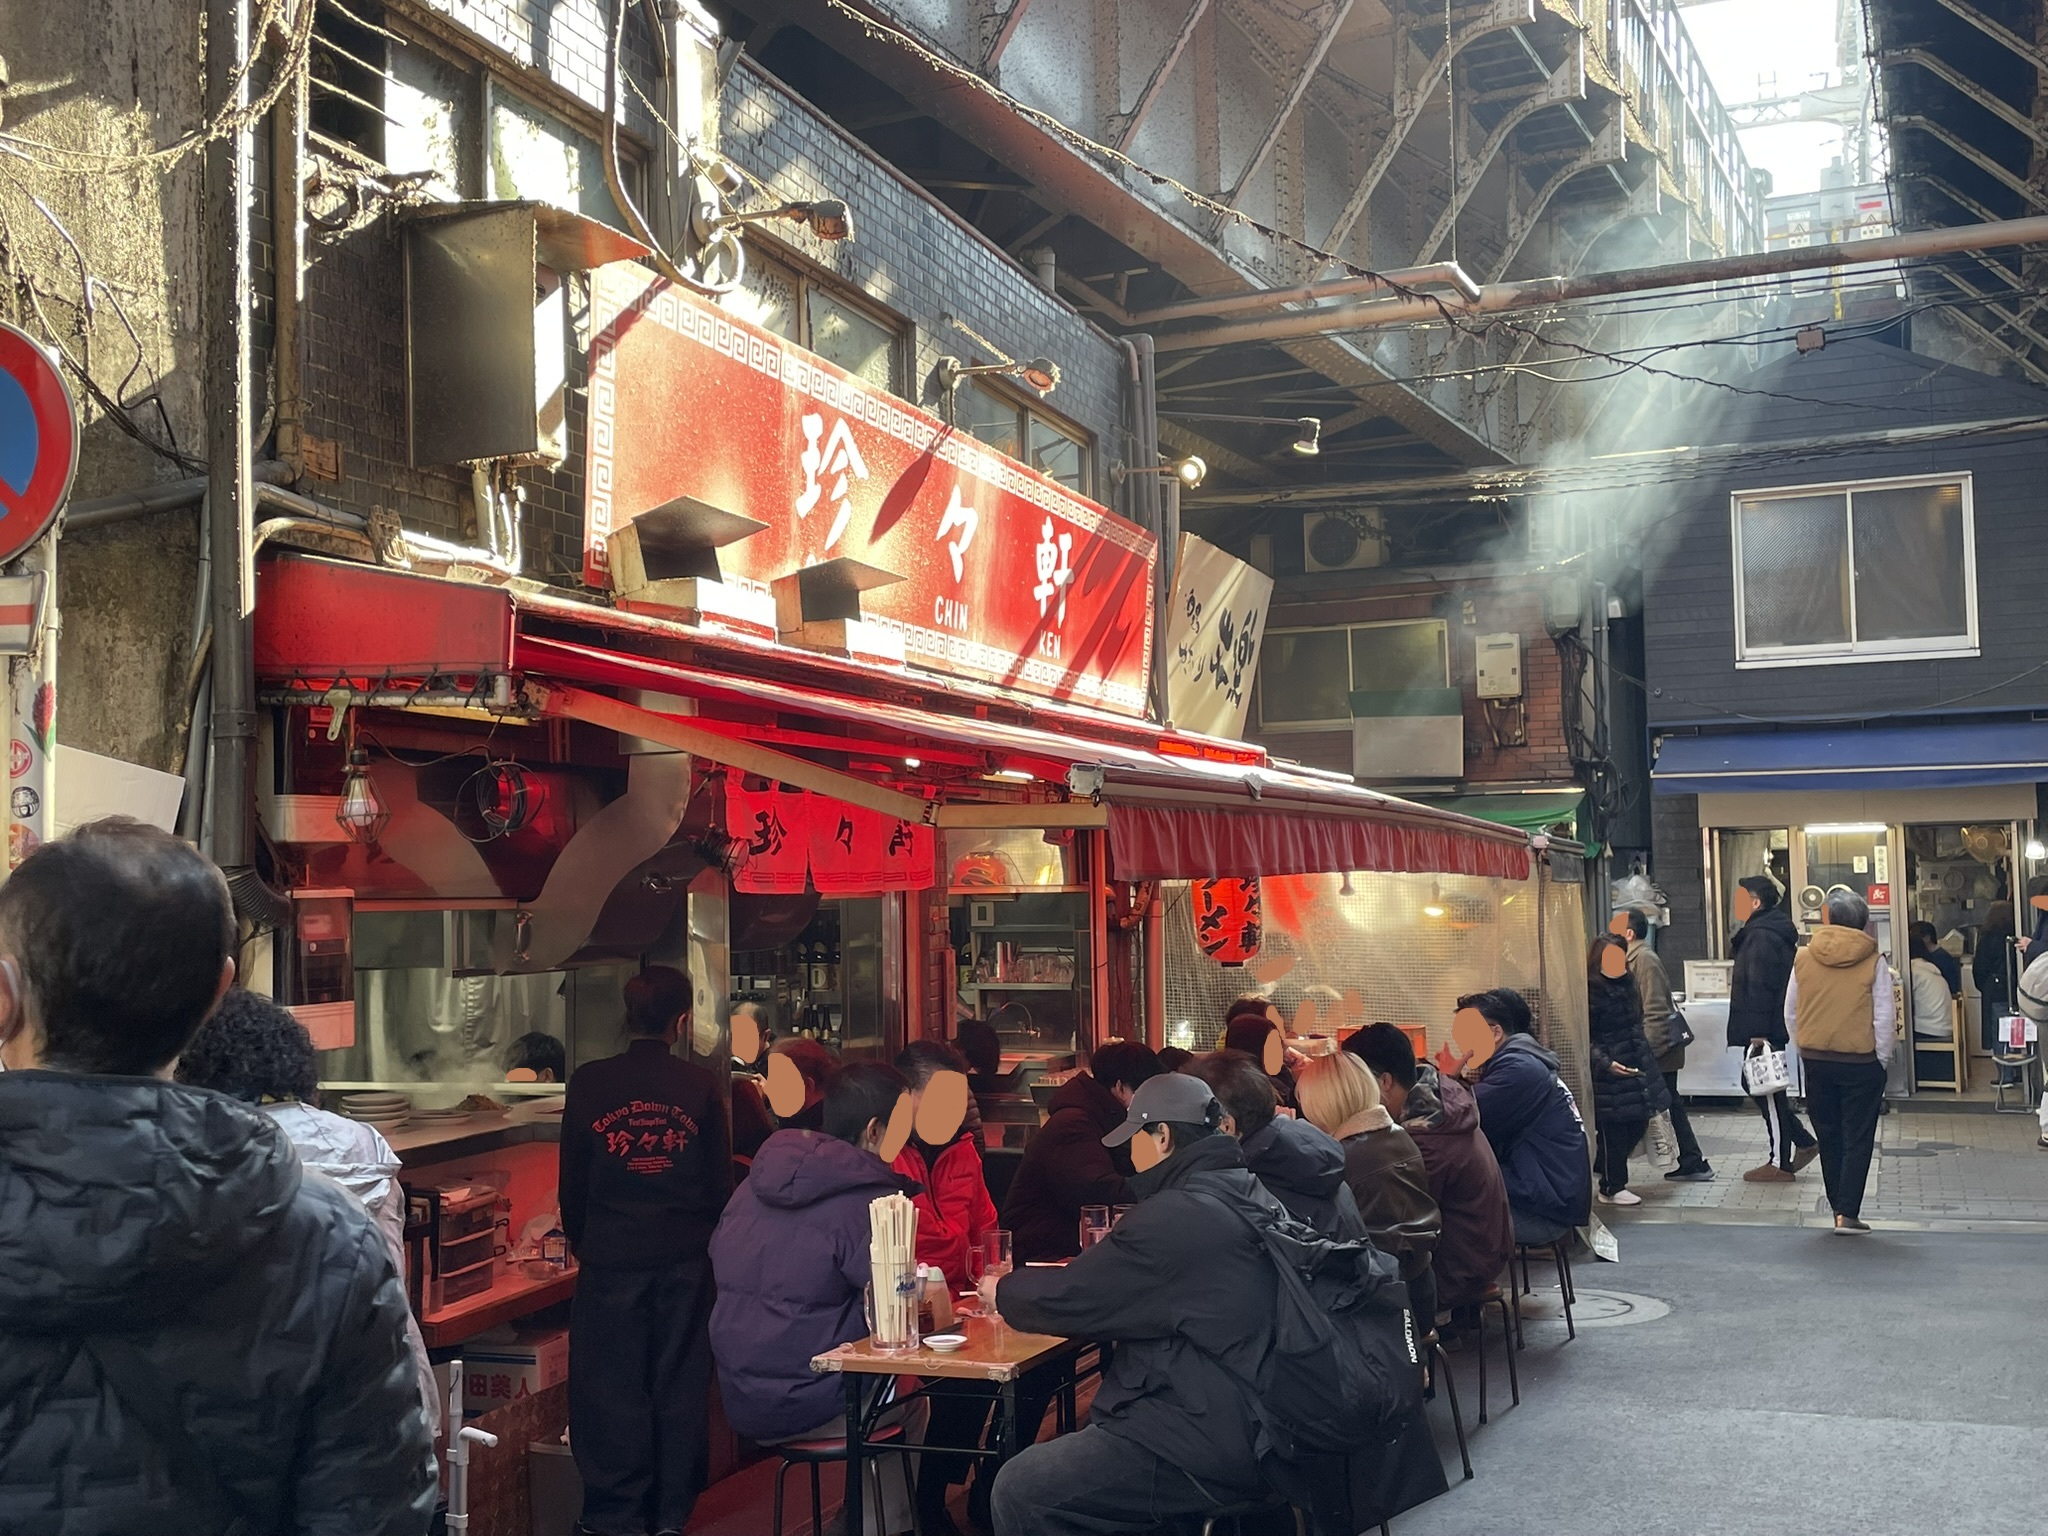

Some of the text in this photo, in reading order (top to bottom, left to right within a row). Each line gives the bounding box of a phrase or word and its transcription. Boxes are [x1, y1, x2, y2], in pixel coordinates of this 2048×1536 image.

[796, 412, 1075, 629] 珍々軒
[934, 595, 1061, 660] CHIN KEN
[592, 1106, 630, 1133] Tokyo
[629, 1100, 670, 1114] Down
[670, 1105, 699, 1136] Town
[606, 1128, 689, 1157] 珍々軒
[1403, 1308, 1418, 1364] SALOMON
[463, 1373, 531, 1400] 田美人
